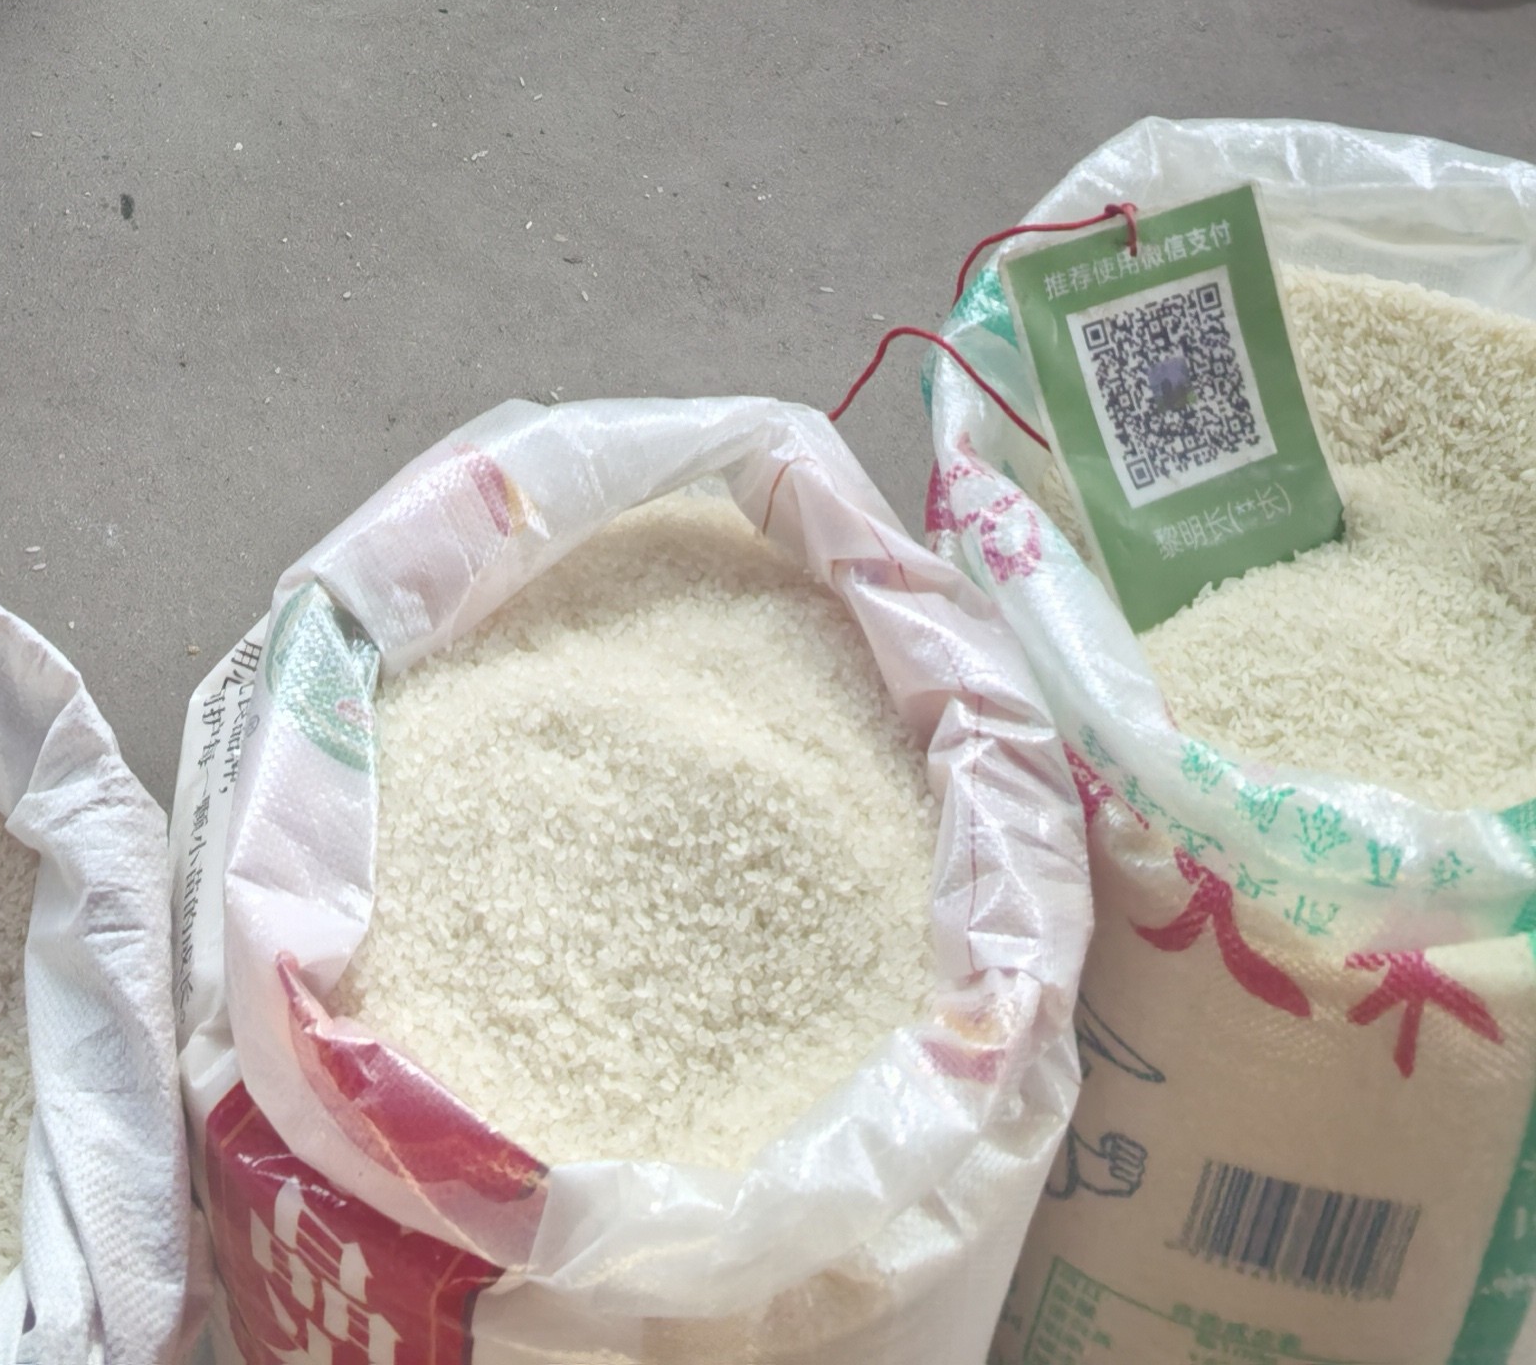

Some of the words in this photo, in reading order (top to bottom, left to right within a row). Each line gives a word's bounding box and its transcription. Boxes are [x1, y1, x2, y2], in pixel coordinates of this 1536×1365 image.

[1043, 218, 1232, 302] 推荐使用微信支付
